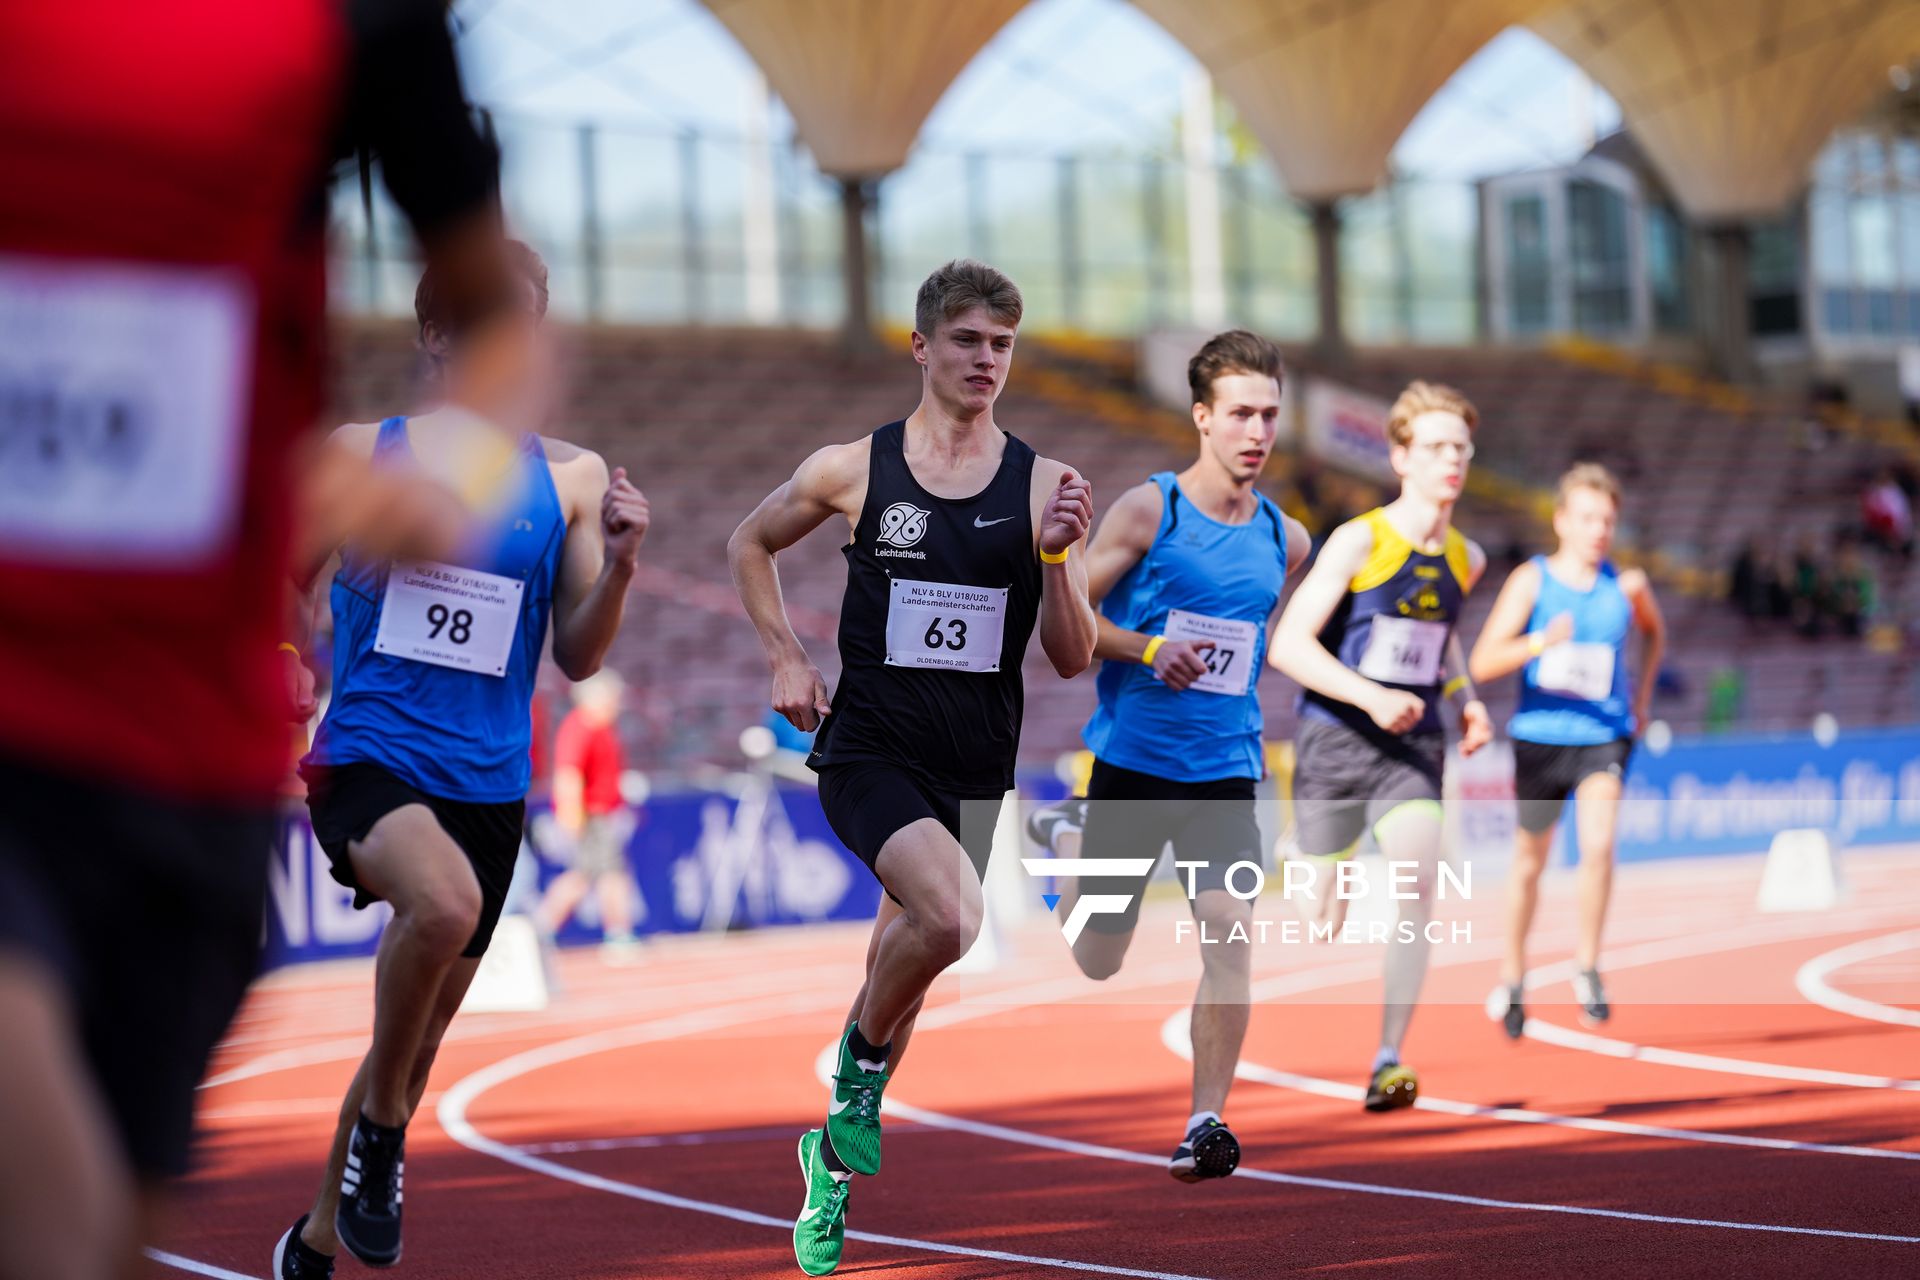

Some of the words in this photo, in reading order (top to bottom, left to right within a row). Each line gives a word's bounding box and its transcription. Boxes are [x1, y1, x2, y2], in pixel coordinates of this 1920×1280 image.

[875, 548, 927, 560] Leichtathletik
[911, 587, 928, 596] NLV
[929, 589, 935, 597] &
[954, 592, 989, 602] U18/U20
[901, 597, 996, 612] Landesmeisterschaften
[427, 603, 473, 645] 98
[924, 617, 967, 651] 63
[916, 657, 954, 666] OLDENBURG
